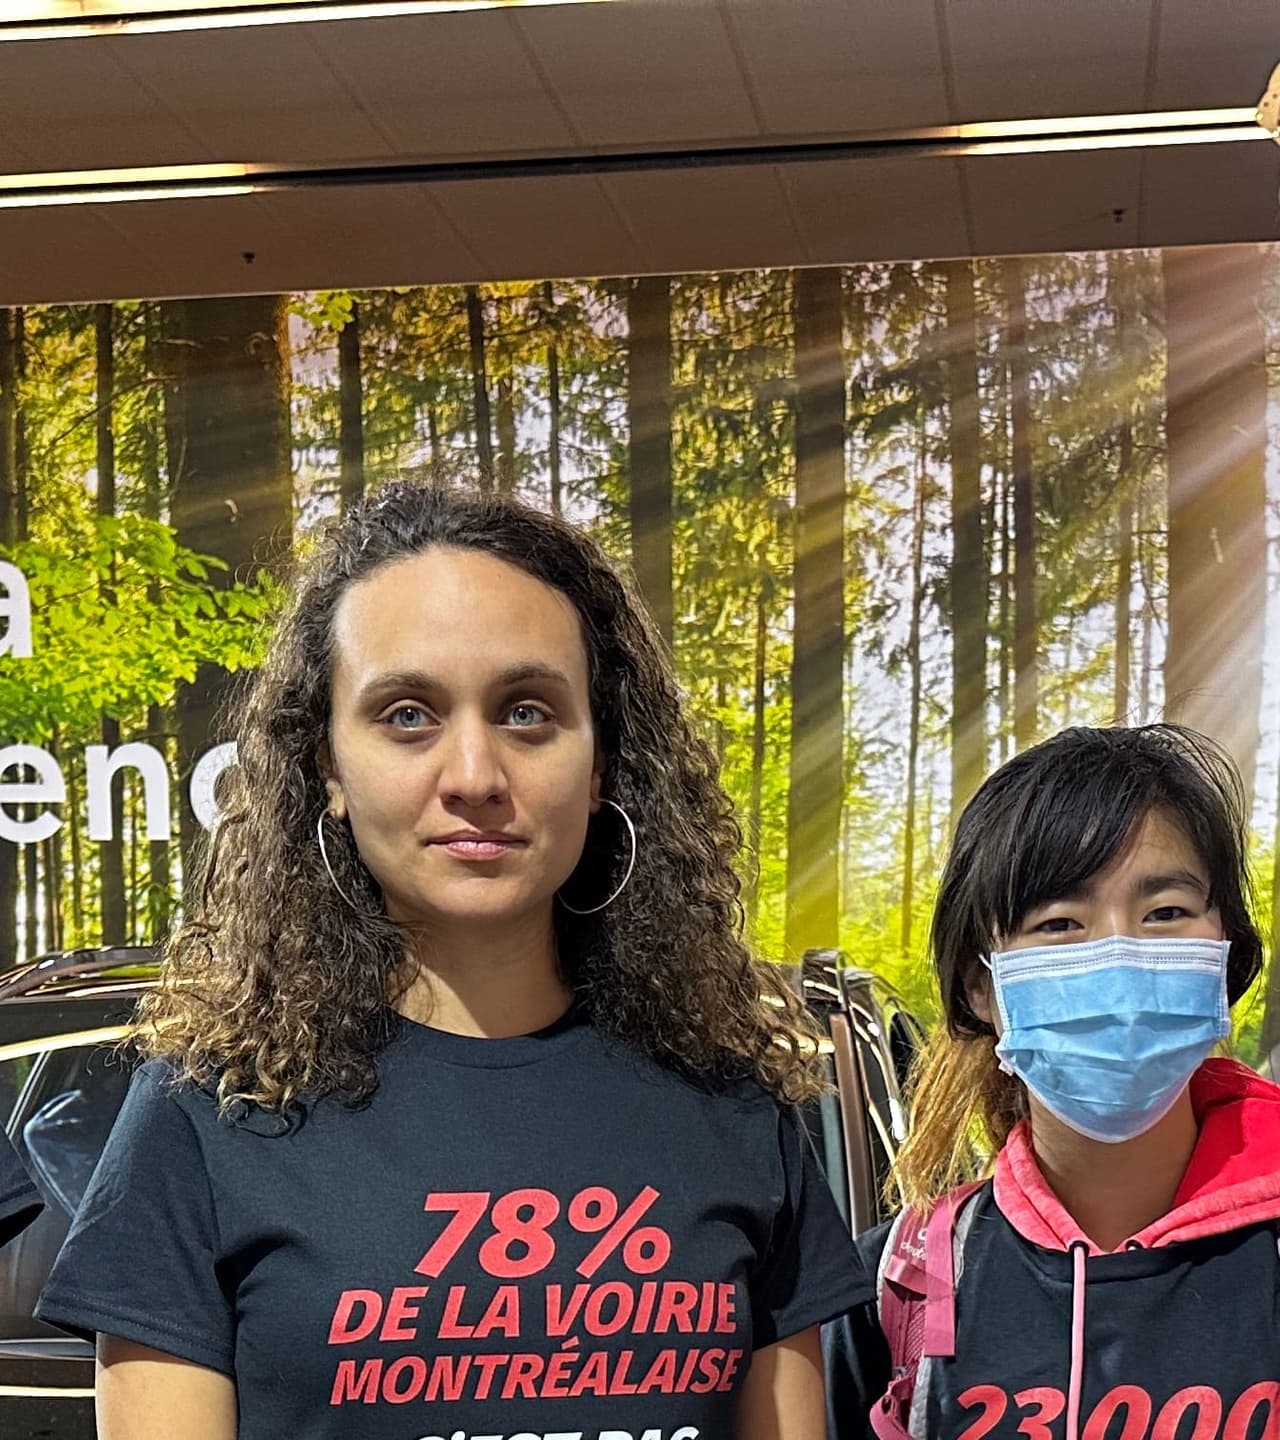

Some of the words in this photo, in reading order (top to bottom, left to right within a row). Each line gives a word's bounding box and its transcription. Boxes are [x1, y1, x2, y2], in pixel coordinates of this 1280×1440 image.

[413, 1185, 672, 1279] 78%
[327, 1286, 428, 1345] DE
[437, 1285, 520, 1340] LA
[545, 1281, 738, 1337] VOIRIE
[329, 1336, 744, 1407] MONTRÉALAISE
